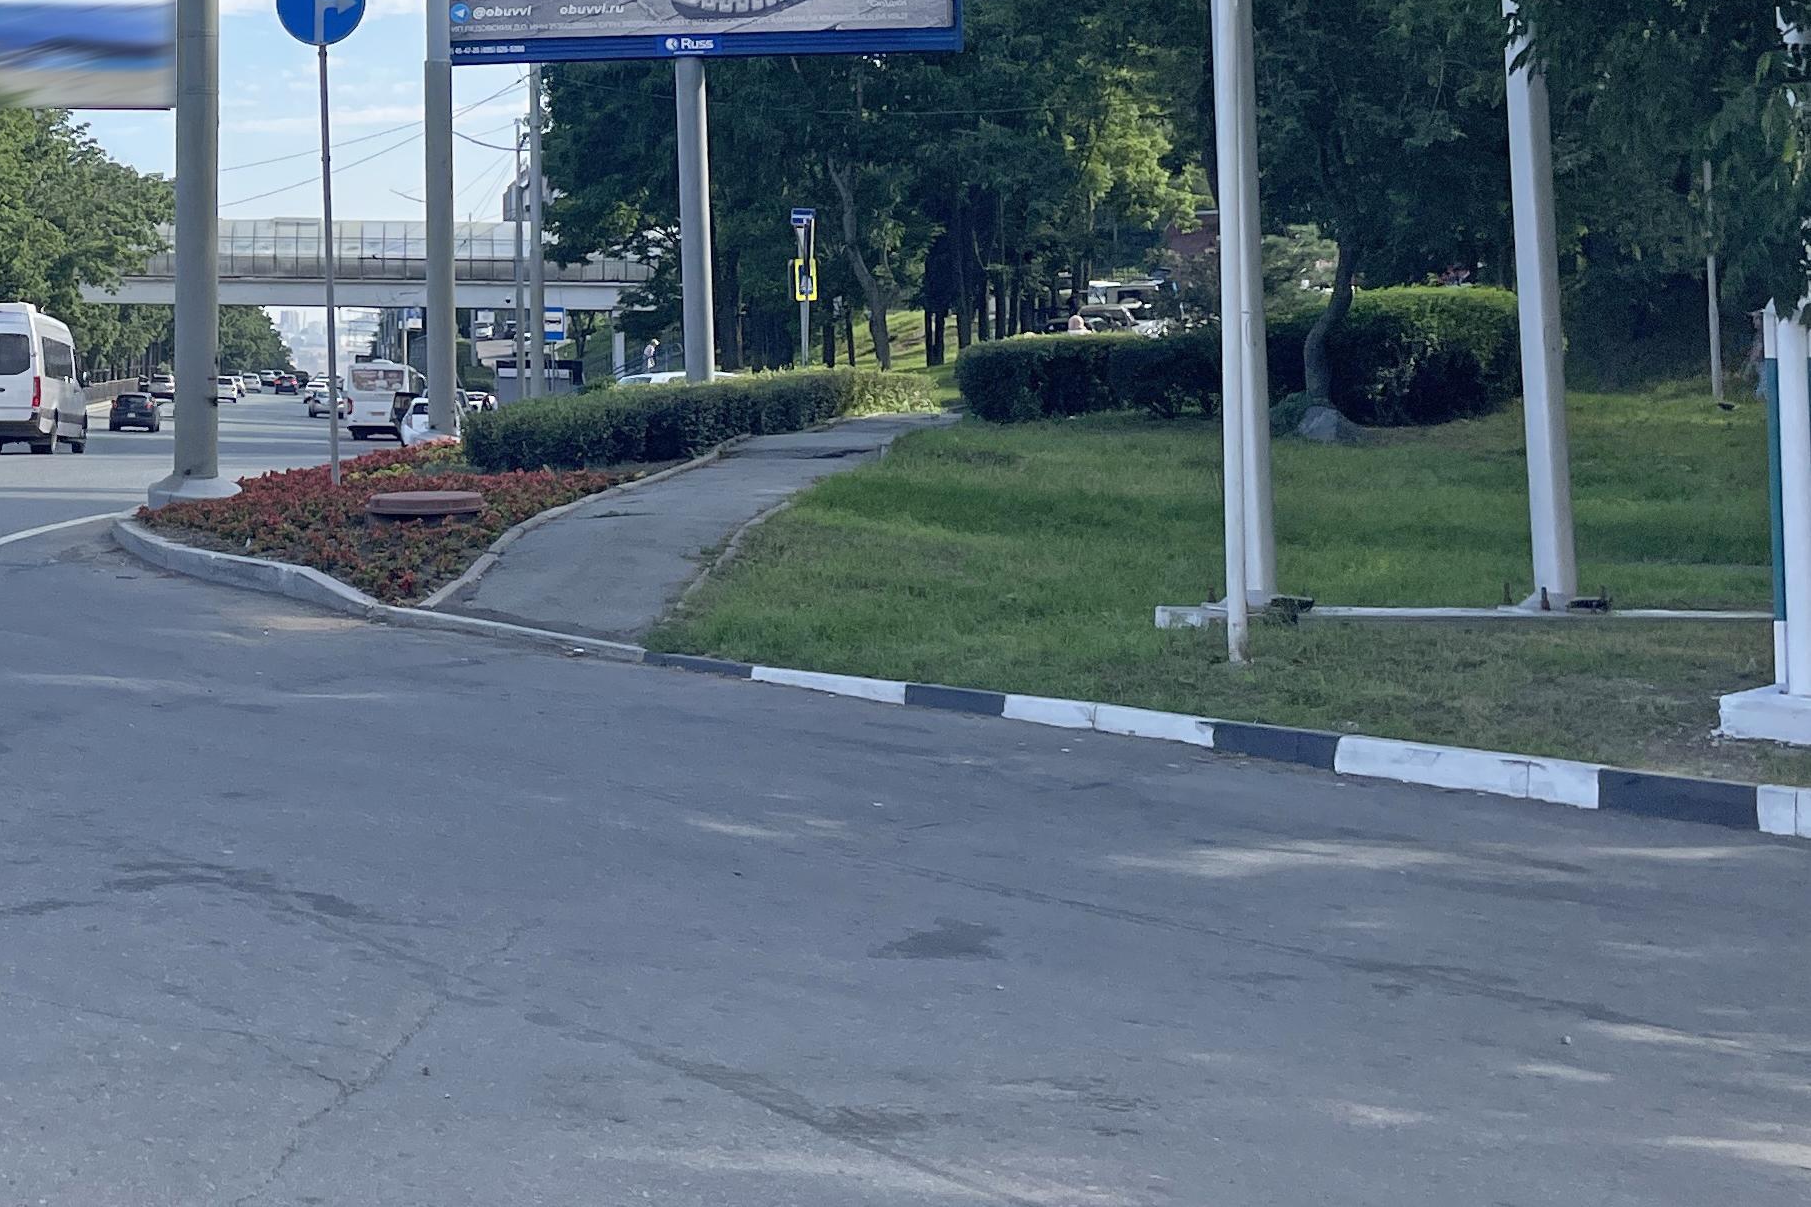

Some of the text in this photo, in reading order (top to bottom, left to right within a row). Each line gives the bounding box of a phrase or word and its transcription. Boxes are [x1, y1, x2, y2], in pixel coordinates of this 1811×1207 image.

[472, 5, 533, 20] @obuvvl
[559, 3, 625, 15] obuvvl.ru
[680, 37, 714, 50] Russ
